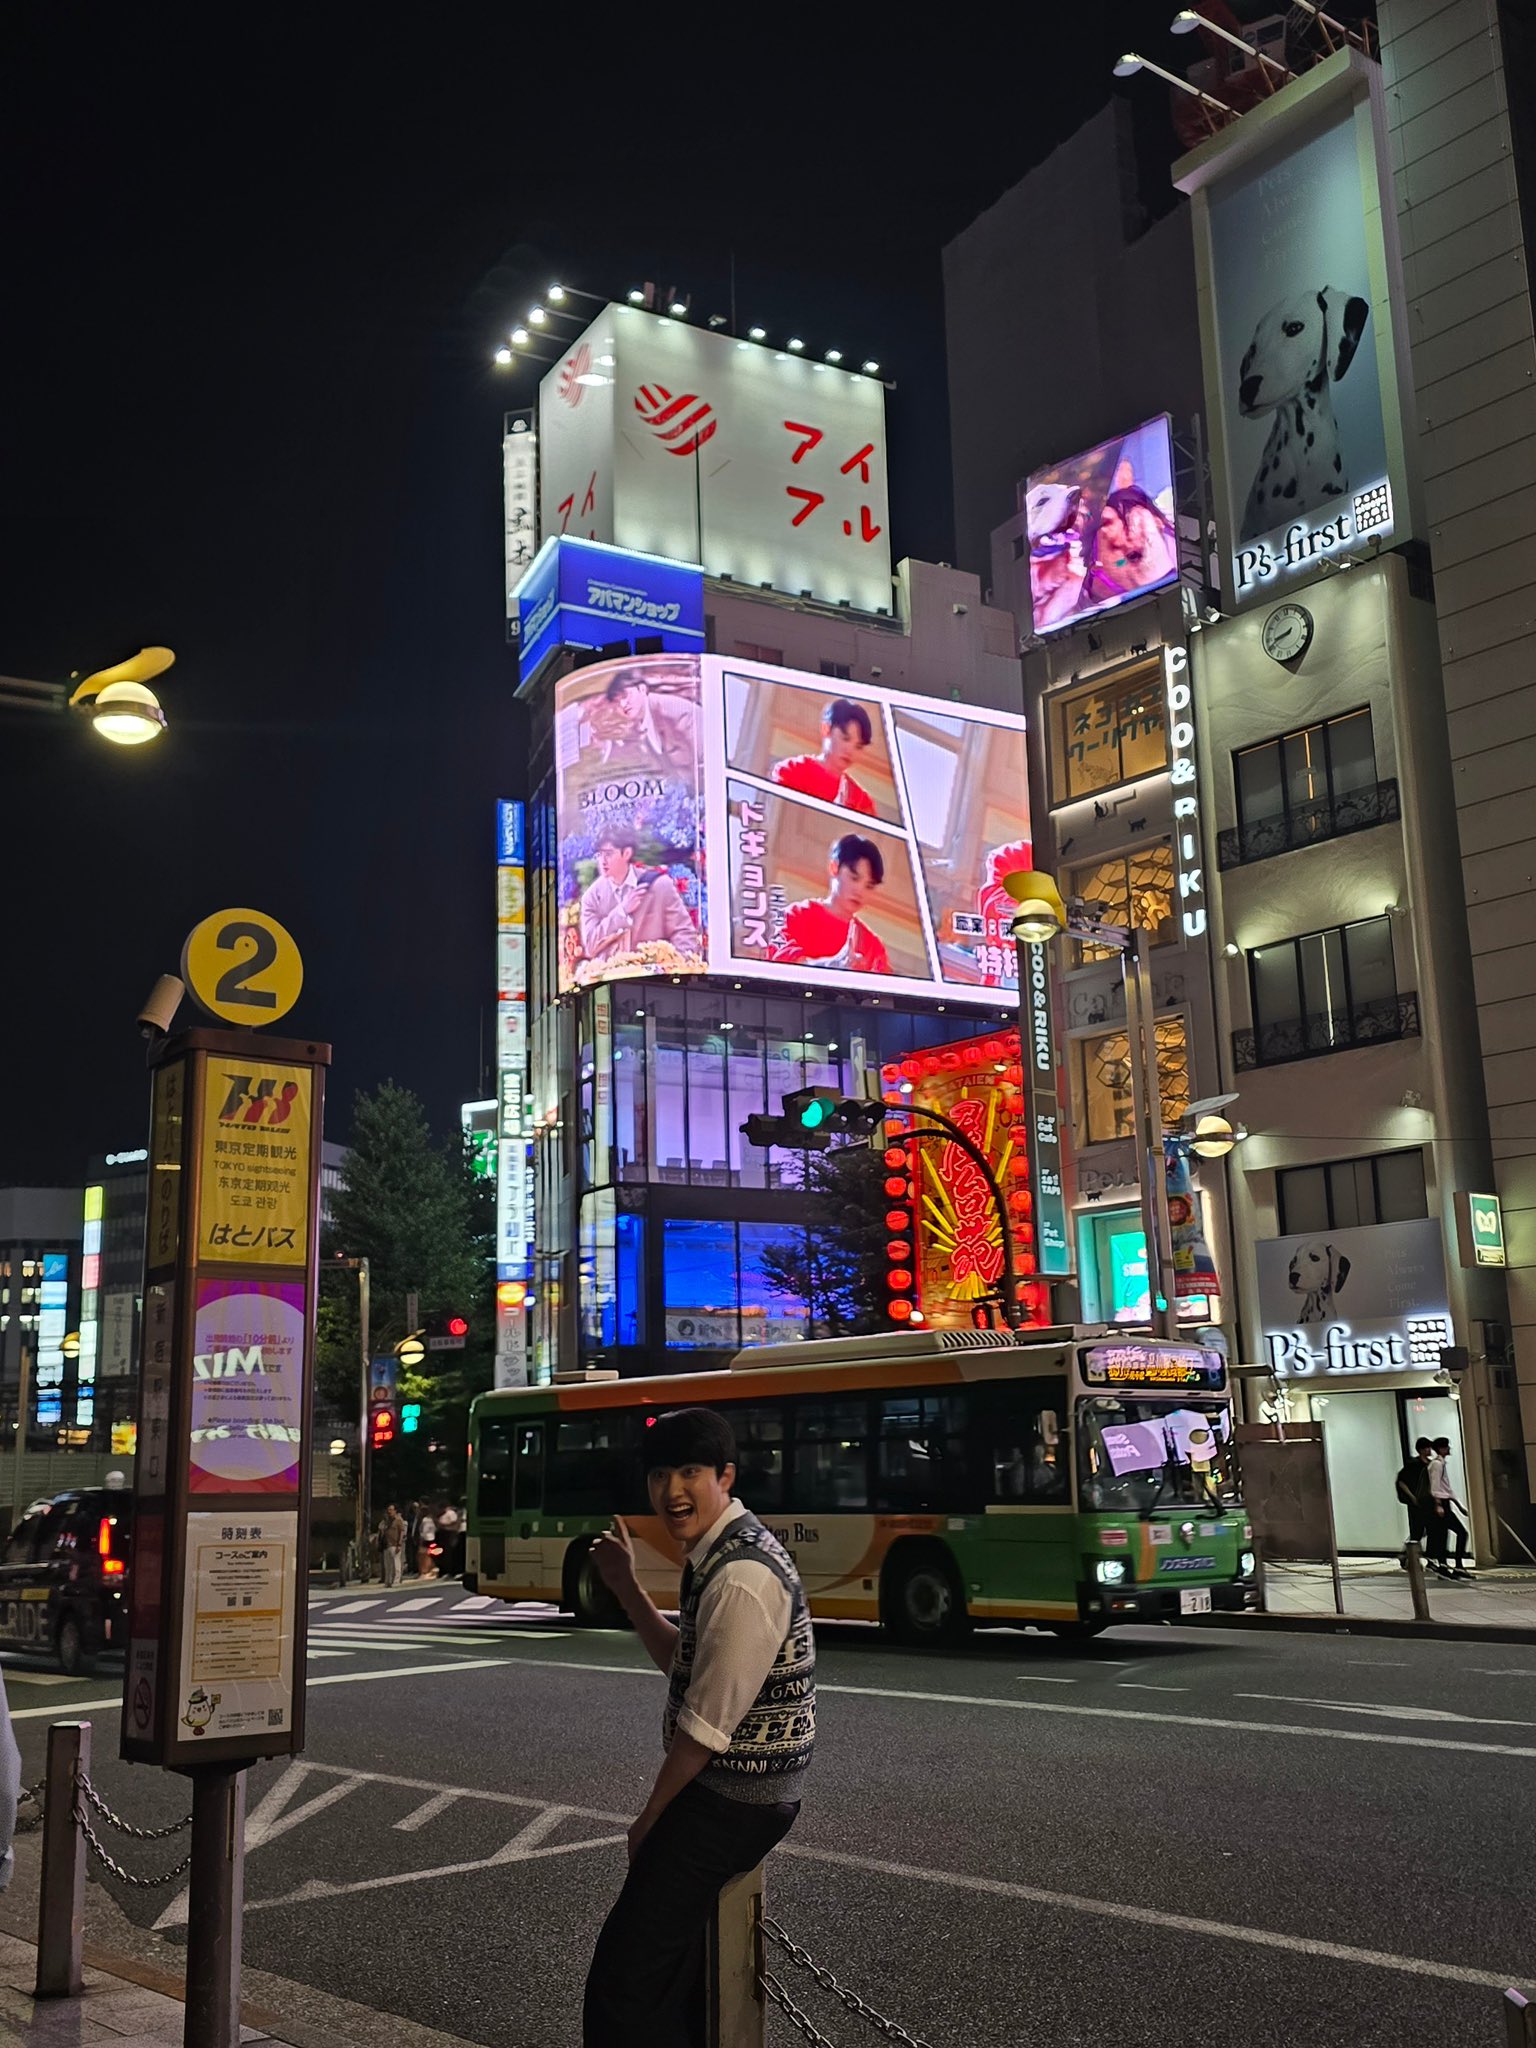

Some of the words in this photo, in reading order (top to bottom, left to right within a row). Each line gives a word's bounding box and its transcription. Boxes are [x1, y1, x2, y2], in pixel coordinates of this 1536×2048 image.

[214, 921, 278, 1009] 2
[214, 1140, 297, 1160] 東京定期観光
[213, 1159, 246, 1172] TOKYO
[217, 1176, 291, 1194] 东京定期观光
[230, 1195, 253, 1207] 도쿄
[255, 1196, 277, 1210] 관광
[208, 1222, 297, 1250] はとバス
[1263, 1326, 1405, 1374] P's-first
[221, 1526, 262, 1540] 時刻表
[793, 1522, 820, 1543] Bus
